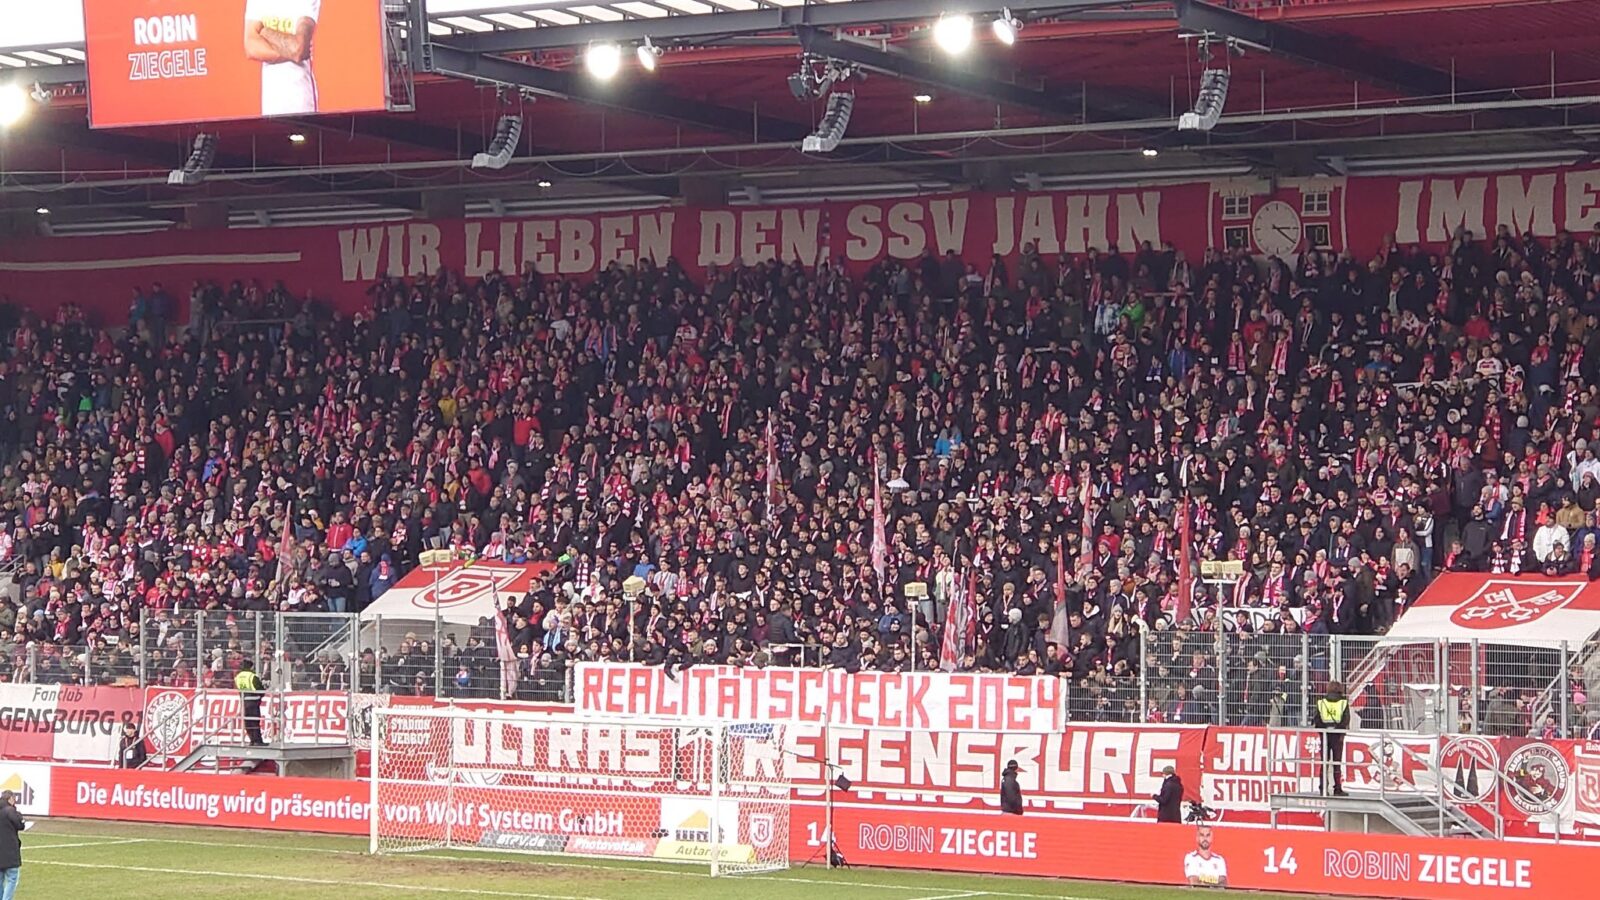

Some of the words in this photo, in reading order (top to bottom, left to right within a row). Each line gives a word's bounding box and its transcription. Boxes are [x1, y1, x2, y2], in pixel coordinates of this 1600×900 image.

[133, 14, 196, 45] ROBIN
[127, 48, 208, 81] ZIEGELE
[338, 222, 442, 281] WIR
[463, 212, 676, 278] LIEBEN
[698, 207, 822, 268] DEN
[846, 198, 970, 261] SSV
[993, 191, 1164, 256] JAHN
[33, 686, 83, 703] Fanclub
[582, 665, 931, 729] REALITÄTSCHECK
[948, 676, 1060, 731] 2024
[391, 718, 431, 730] STADION
[391, 733, 430, 745] VERBOT
[452, 708, 661, 774] ULTRAS
[742, 727, 1181, 796] REGENSBURG
[1212, 733, 1298, 773] JAHN
[77, 781, 108, 806] Die
[111, 782, 219, 817] Aufstellung
[223, 789, 267, 812] wird
[385, 805, 421, 824] von
[425, 800, 477, 828] Wolf
[478, 803, 553, 832] System
[559, 808, 624, 835] GmbH
[859, 822, 935, 854] ROBIN
[940, 828, 1038, 860] ZIEGELE
[1262, 846, 1298, 874] 14
[1324, 848, 1410, 881] ROBIN
[1418, 853, 1532, 888] ZIEGELE
